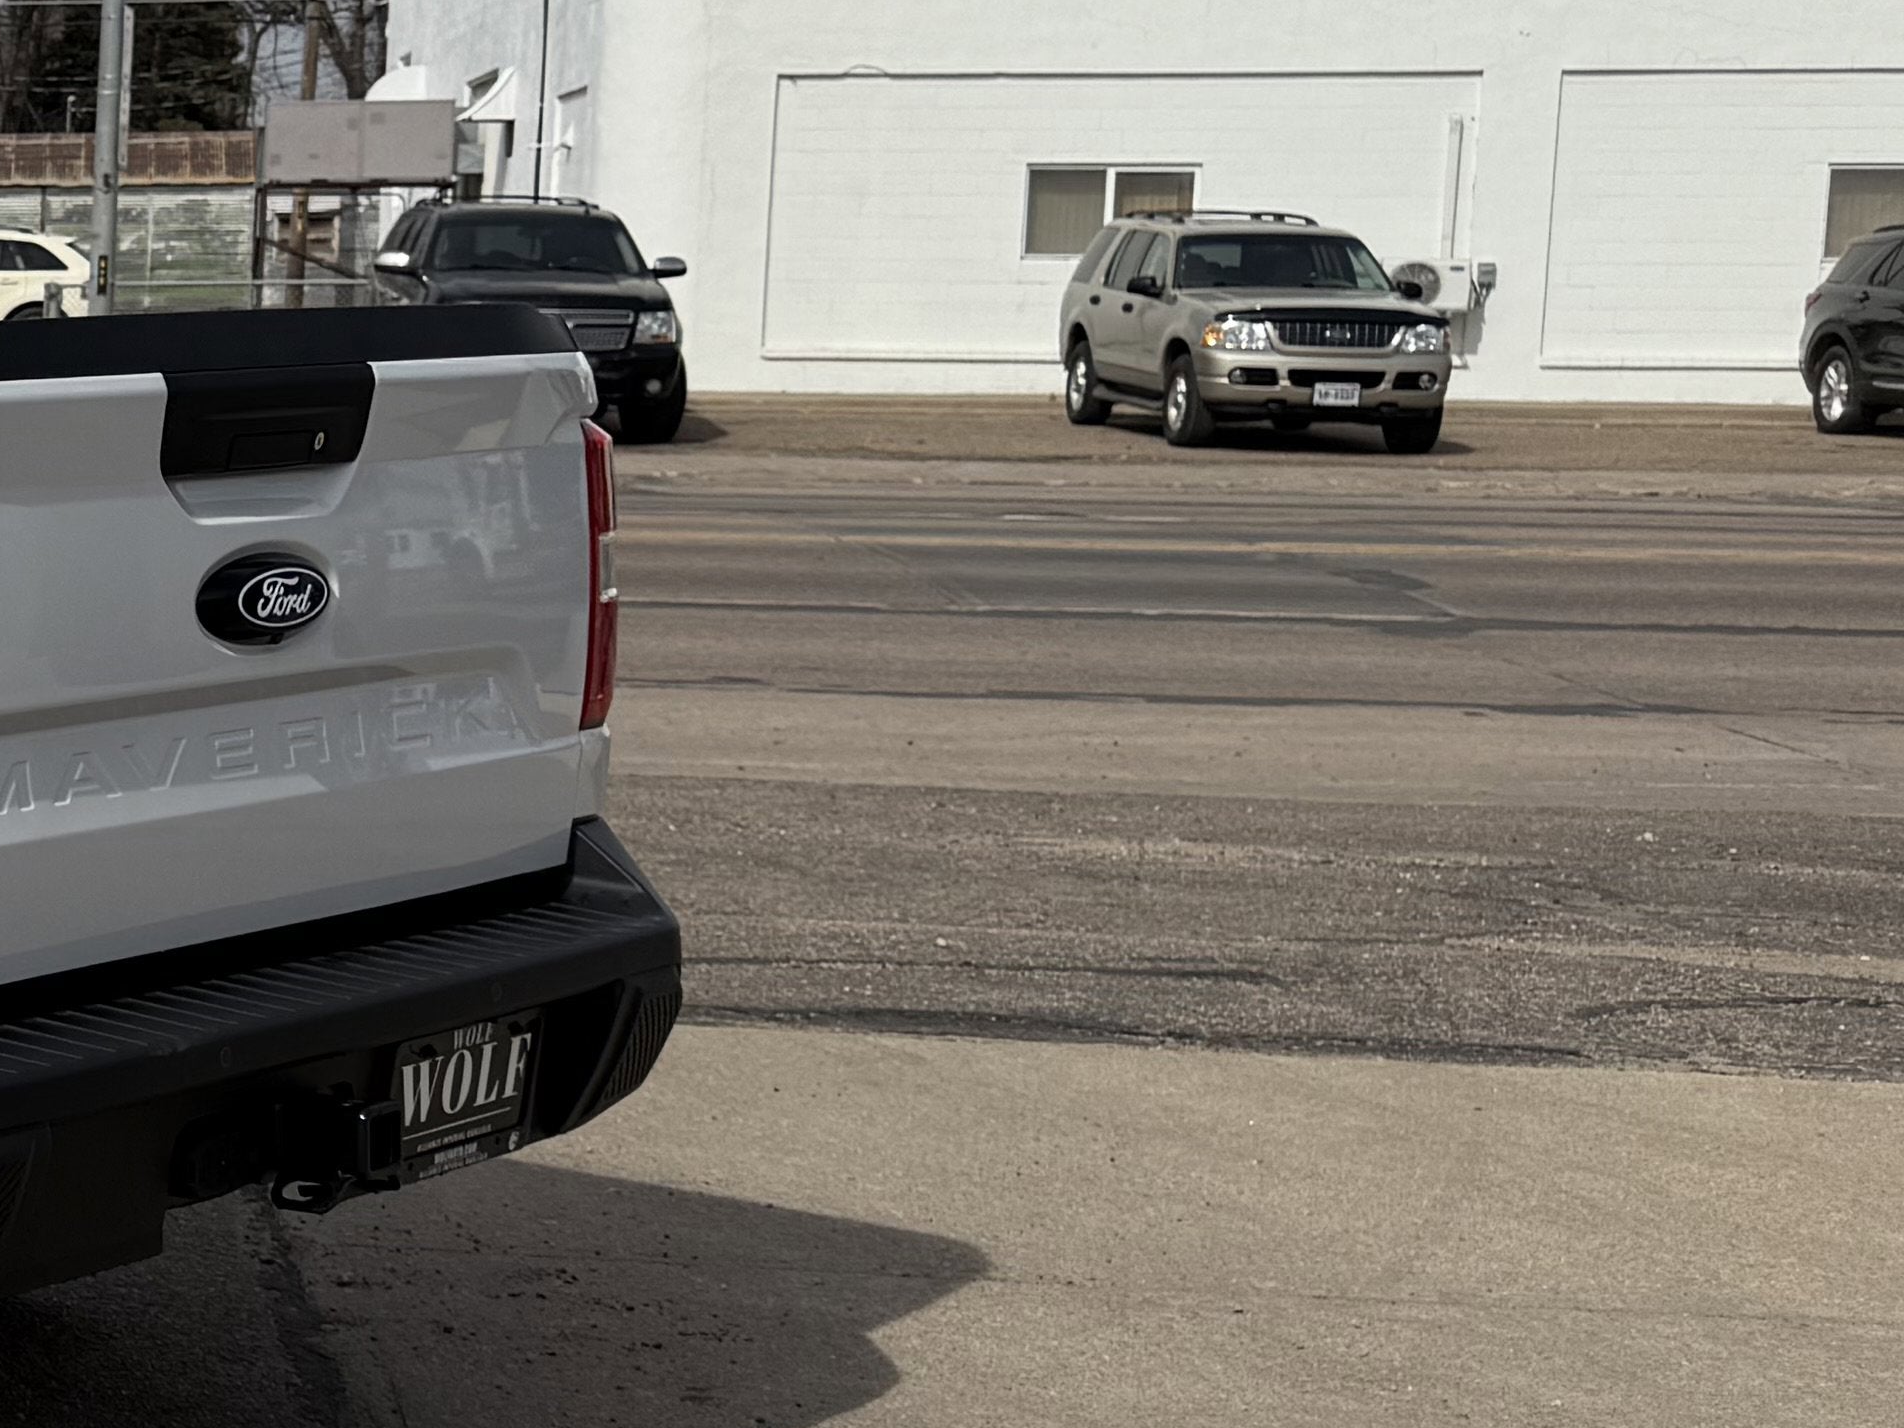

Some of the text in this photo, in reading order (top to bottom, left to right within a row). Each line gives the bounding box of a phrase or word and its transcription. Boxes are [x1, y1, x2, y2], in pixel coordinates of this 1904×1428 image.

[257, 575, 313, 618] Ford
[453, 1022, 495, 1050] WOLF
[401, 1032, 533, 1127] WOLF
